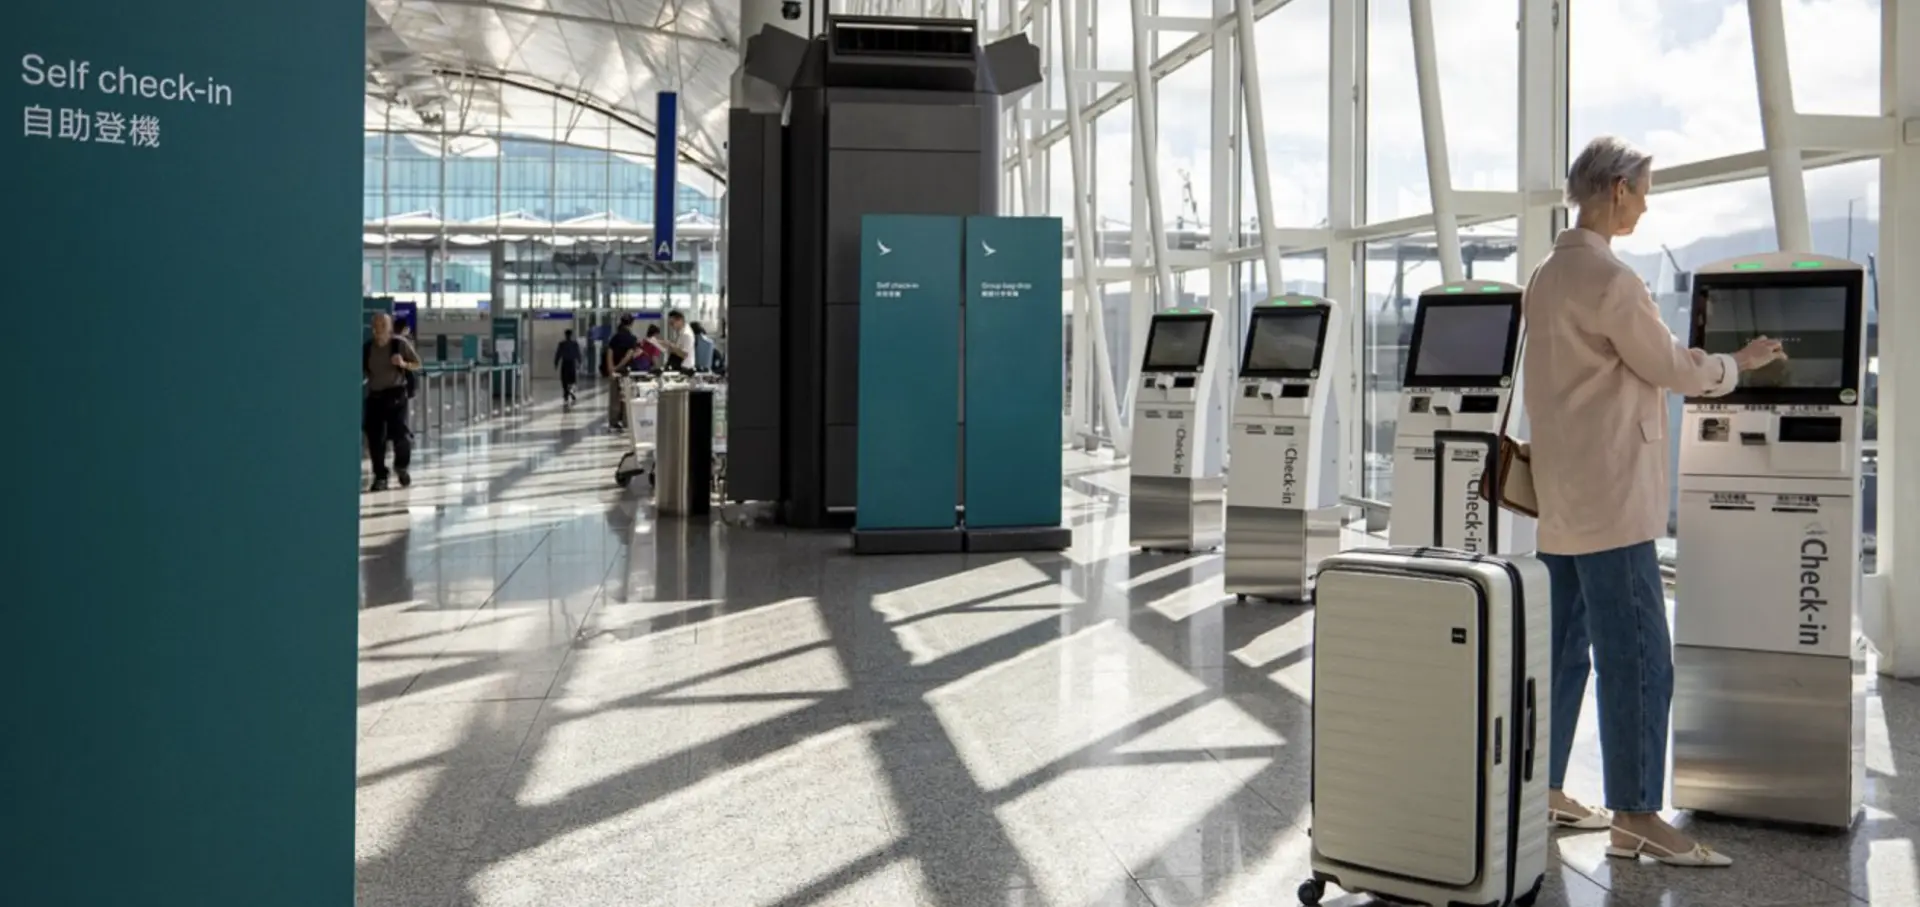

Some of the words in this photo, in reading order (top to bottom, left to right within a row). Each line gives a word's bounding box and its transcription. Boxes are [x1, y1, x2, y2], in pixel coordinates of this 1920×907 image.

[21, 53, 90, 91] Self
[98, 66, 233, 106] check-in
[23, 103, 161, 149] 自助登機
[658, 240, 672, 257] A
[1173, 428, 1186, 475] Check-in
[1282, 447, 1298, 505] Check-in
[1799, 538, 1828, 645] Check-in
